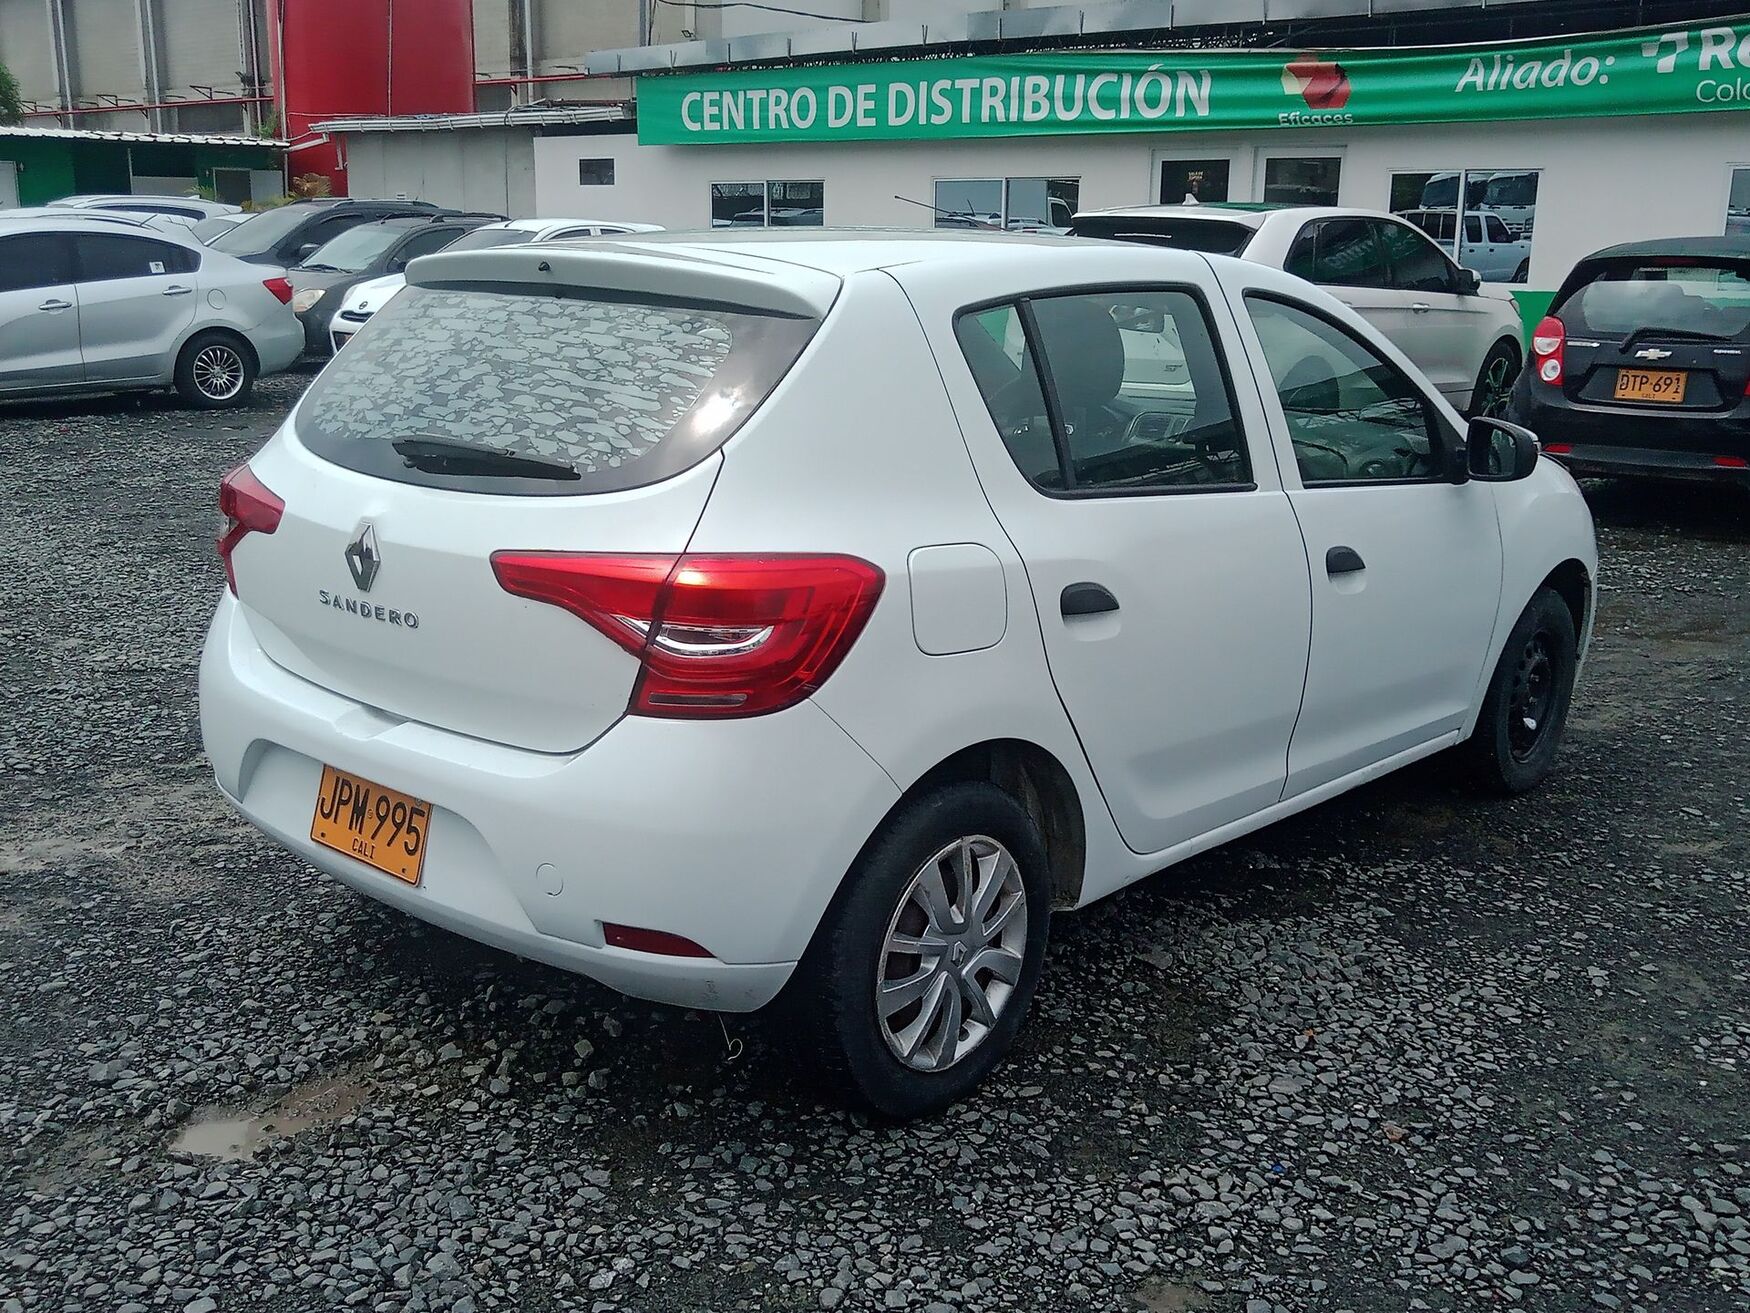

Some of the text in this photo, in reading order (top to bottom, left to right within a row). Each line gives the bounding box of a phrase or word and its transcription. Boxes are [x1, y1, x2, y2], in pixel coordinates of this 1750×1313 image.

[1455, 49, 1616, 93] Aliado:
[681, 64, 1212, 131] CENTRO DE DISTRIBUCIÓN
[1278, 111, 1353, 127] Eficaces
[319, 589, 420, 629] SANDERO
[352, 838, 376, 860] CALI
